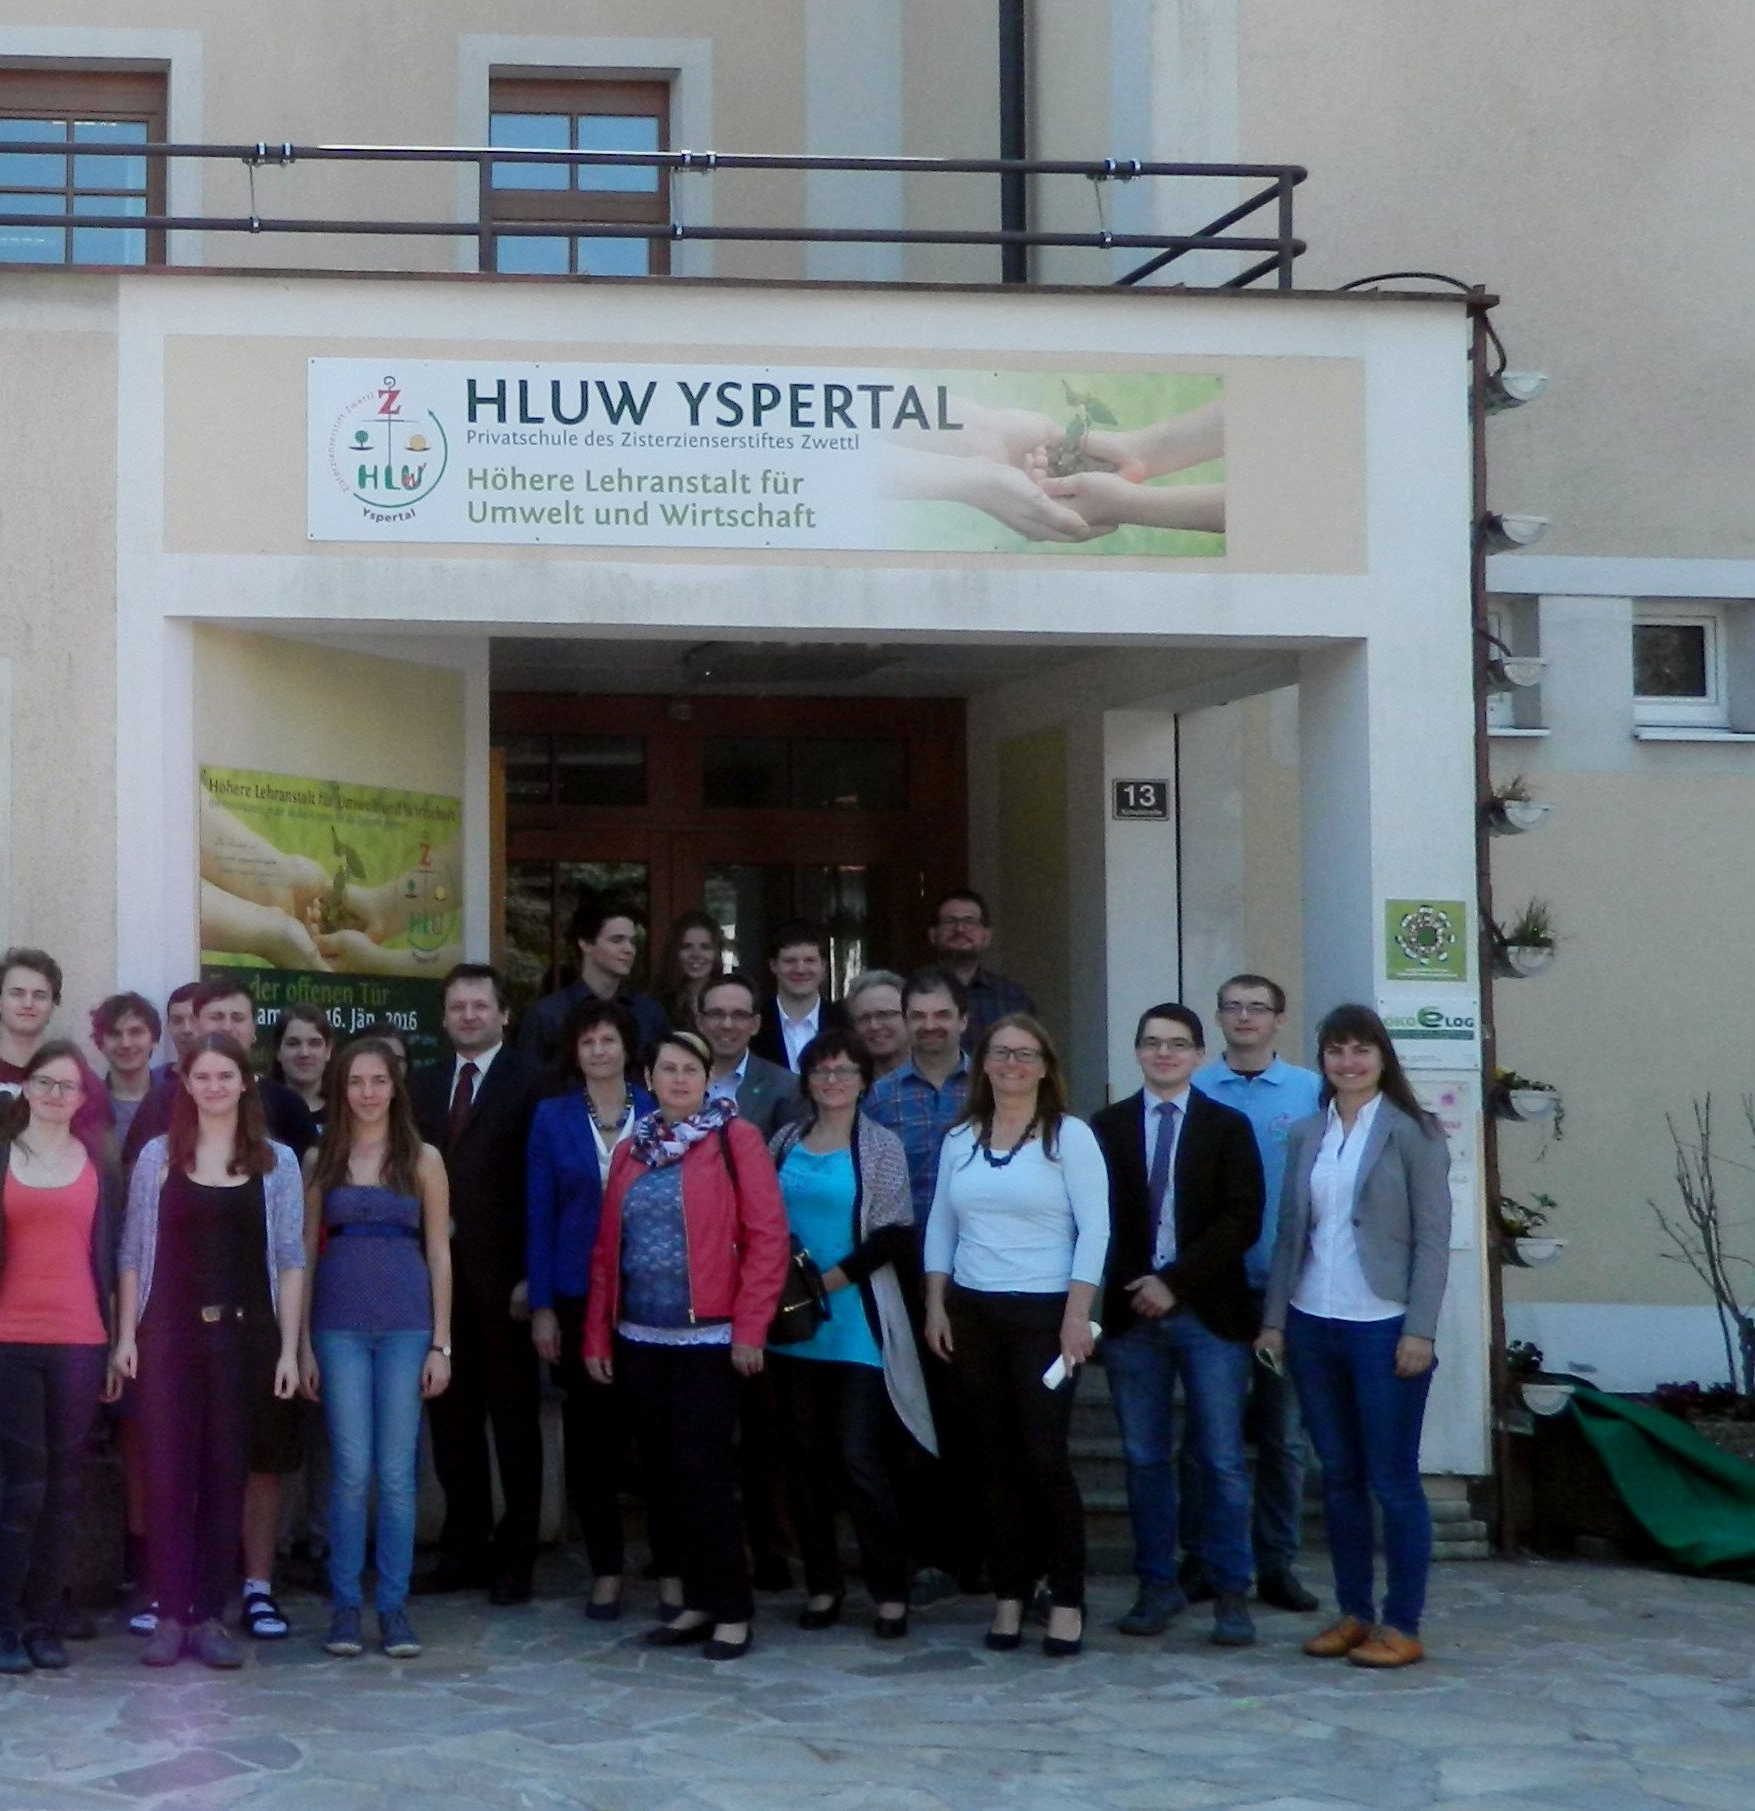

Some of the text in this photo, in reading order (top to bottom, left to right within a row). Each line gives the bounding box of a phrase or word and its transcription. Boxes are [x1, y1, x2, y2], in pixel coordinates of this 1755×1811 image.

[377, 389, 402, 415] Z
[466, 378, 965, 431] HLUW YSPERTAL
[466, 429, 860, 450] Privatschule des Zisterzienserstiftes Zwettl
[467, 466, 805, 495] Höhere Lehranstalt für
[361, 506, 417, 524] Yspertal
[467, 499, 817, 529] Umwelt und Wirtschaft
[1123, 784, 1156, 808] 13
[286, 976, 353, 1004] offenen
[359, 981, 390, 1006] Tür
